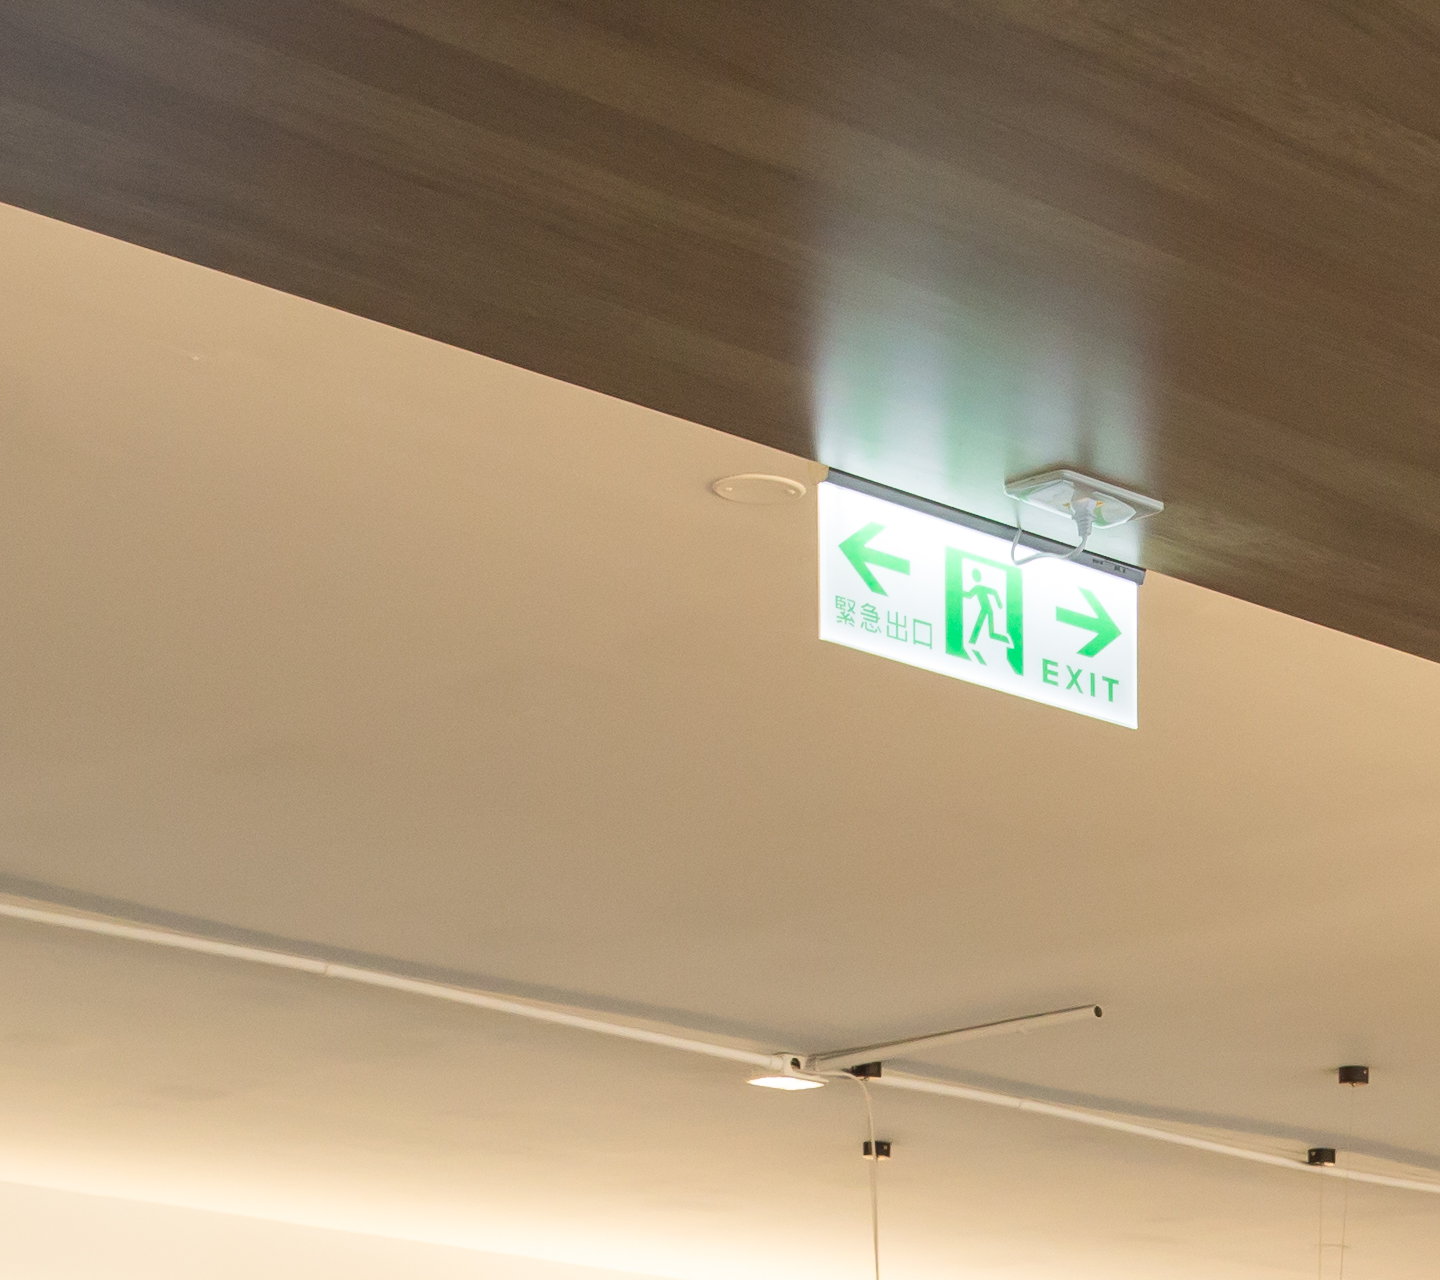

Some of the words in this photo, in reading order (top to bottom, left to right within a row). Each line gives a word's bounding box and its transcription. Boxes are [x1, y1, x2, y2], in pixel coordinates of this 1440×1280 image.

[835, 595, 933, 650] 緊急出口
[1042, 658, 1120, 703] EXIT
